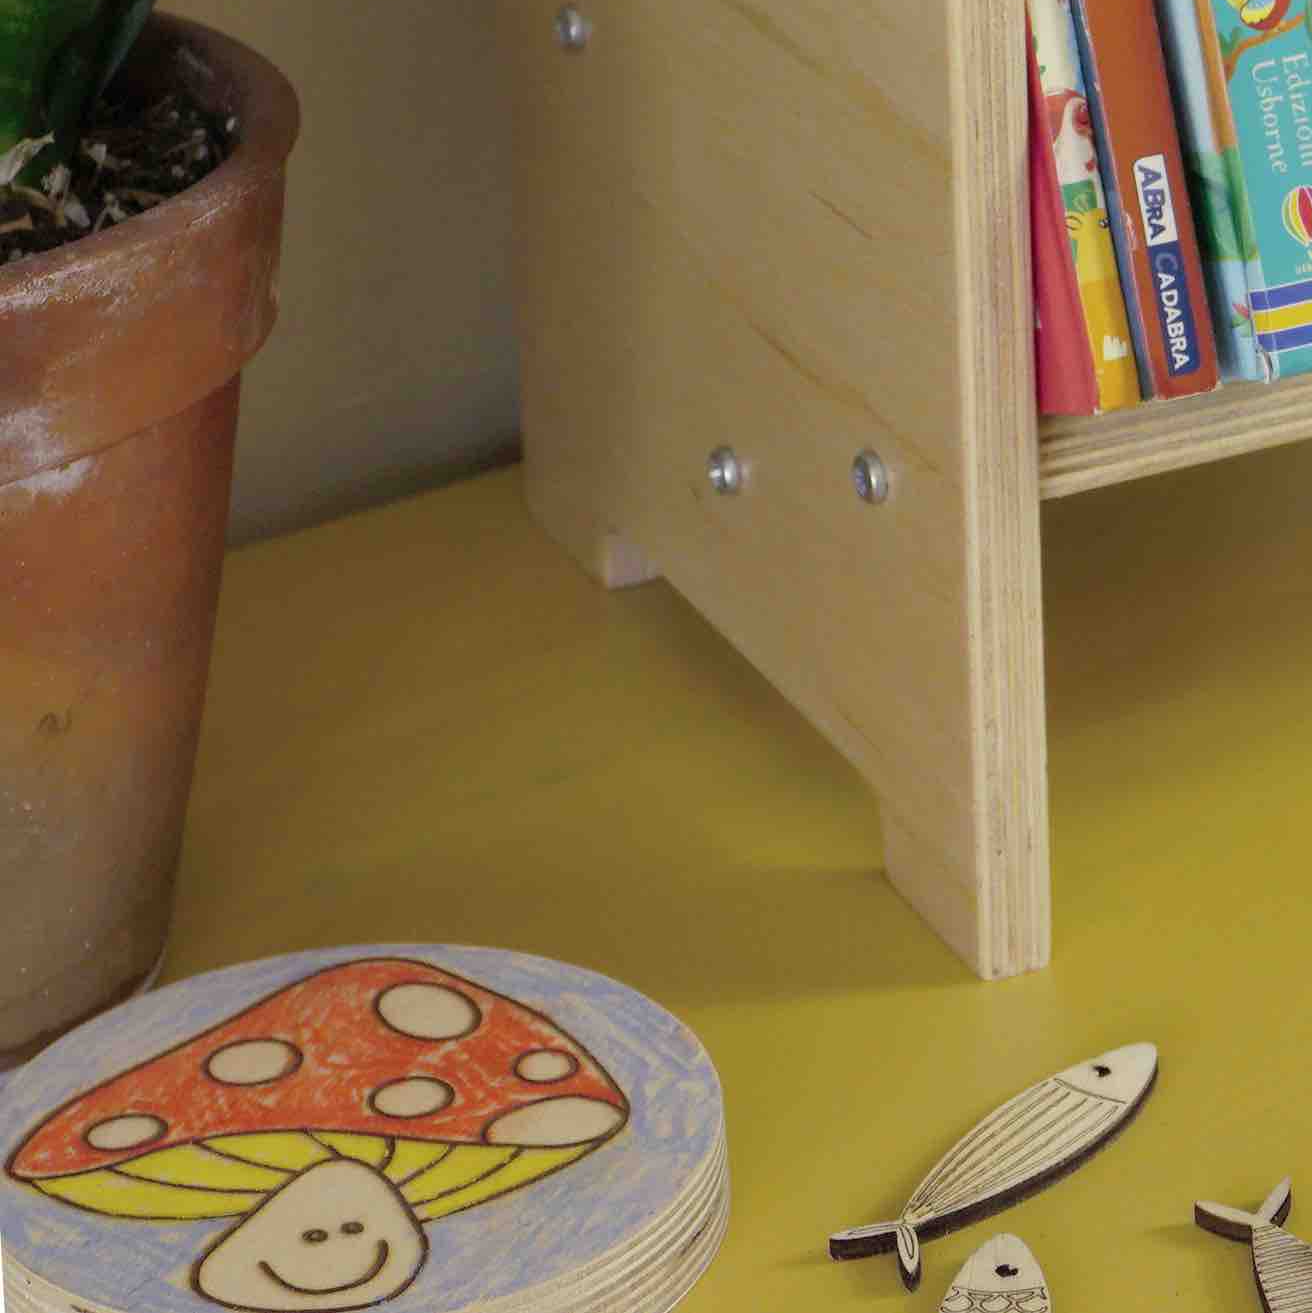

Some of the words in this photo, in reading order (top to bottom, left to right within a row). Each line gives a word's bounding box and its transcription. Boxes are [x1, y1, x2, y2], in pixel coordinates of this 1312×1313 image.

[1251, 59, 1288, 173] Usborne
[1138, 164, 1166, 239] ABRA
[1154, 253, 1191, 370] CADABRA
